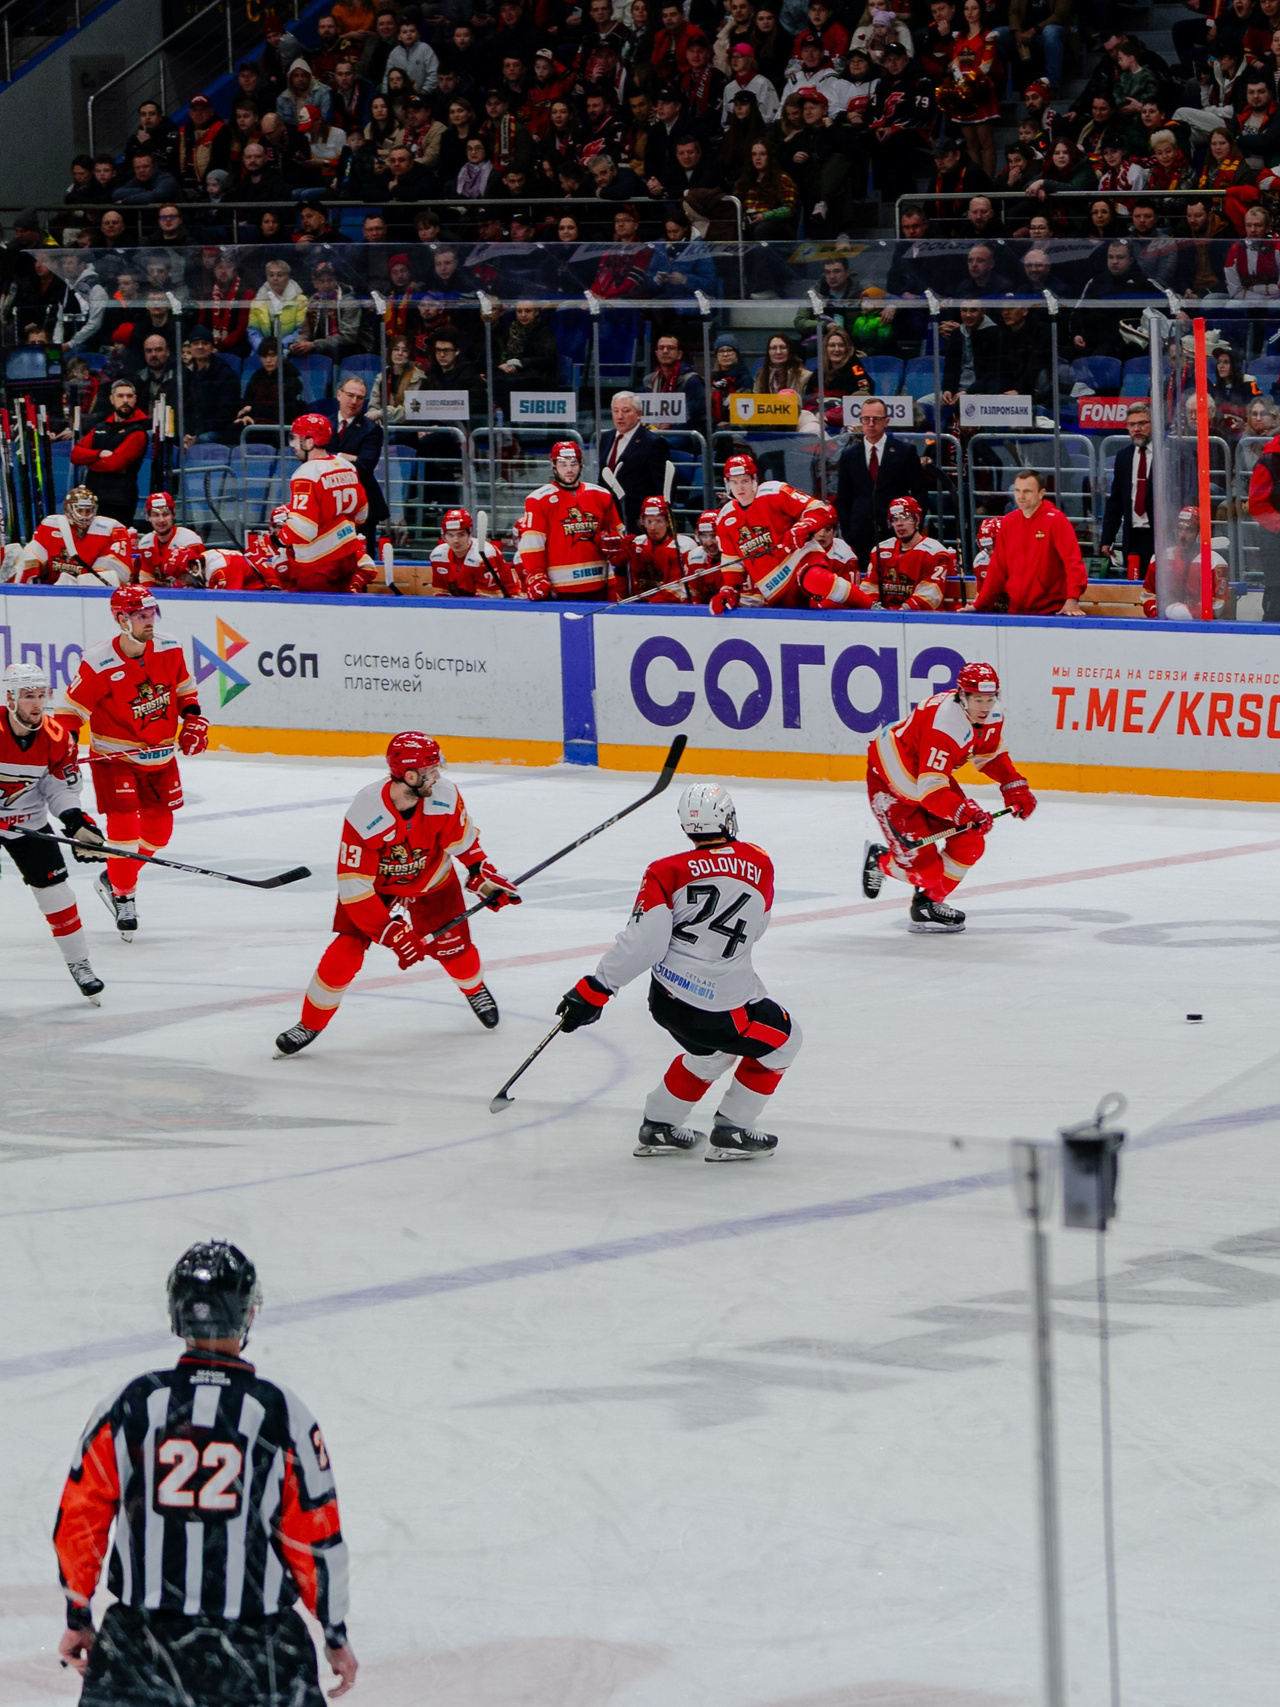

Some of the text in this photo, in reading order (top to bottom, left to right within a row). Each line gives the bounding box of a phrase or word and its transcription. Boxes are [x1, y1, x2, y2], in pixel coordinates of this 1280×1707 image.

[519, 399, 567, 414] SIBUR
[757, 404, 791, 415] БАНК
[980, 405, 1030, 415] ГАЗПРОМБАНК
[1080, 404, 1127, 421] FONB
[292, 494, 309, 510] 12
[332, 487, 358, 516] 12
[336, 525, 353, 540] SIB
[109, 541, 127, 557] 45
[572, 566, 604, 579] SIBUR
[765, 565, 792, 591] SIBUR
[344, 652, 488, 676] система быстрых
[1052, 667, 1071, 677] МЫ
[1076, 668, 1122, 680] ВСЕГДА
[1127, 669, 1143, 679] НА
[1148, 670, 1188, 681] СВЯЗИ
[345, 674, 423, 692] платежей
[131, 692, 171, 720] REDSTAR
[926, 747, 950, 771] 15
[690, 823, 704, 833] 24
[379, 855, 427, 875] REDSTAR
[688, 857, 762, 885] SOLOVYEV
[671, 884, 752, 959] 24
[437, 945, 465, 956] CCM
[157, 1438, 243, 1510] 22
